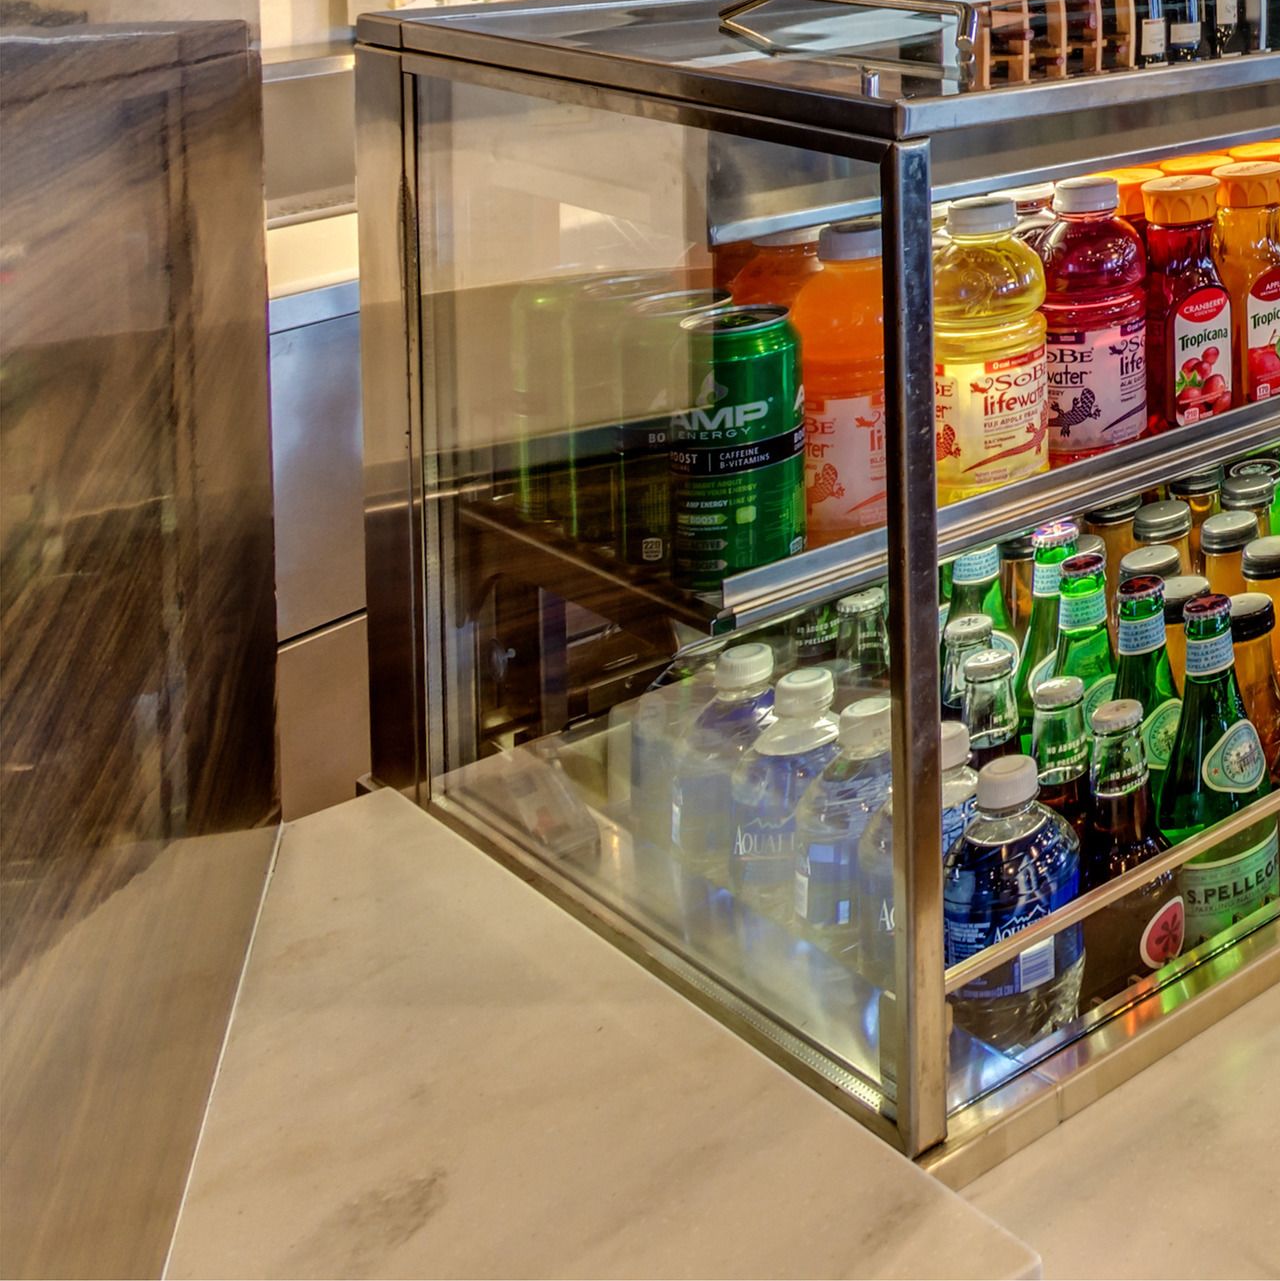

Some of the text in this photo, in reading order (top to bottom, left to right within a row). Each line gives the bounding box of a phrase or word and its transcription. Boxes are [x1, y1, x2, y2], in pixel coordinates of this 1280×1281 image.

[1184, 297, 1224, 314] CRANBERRY
[1179, 328, 1228, 351] Tropicana
[670, 400, 770, 431] AMP
[678, 426, 751, 440] ENERGY
[719, 446, 760, 461] CAFFEINE
[719, 452, 770, 469] B-VITAMINS
